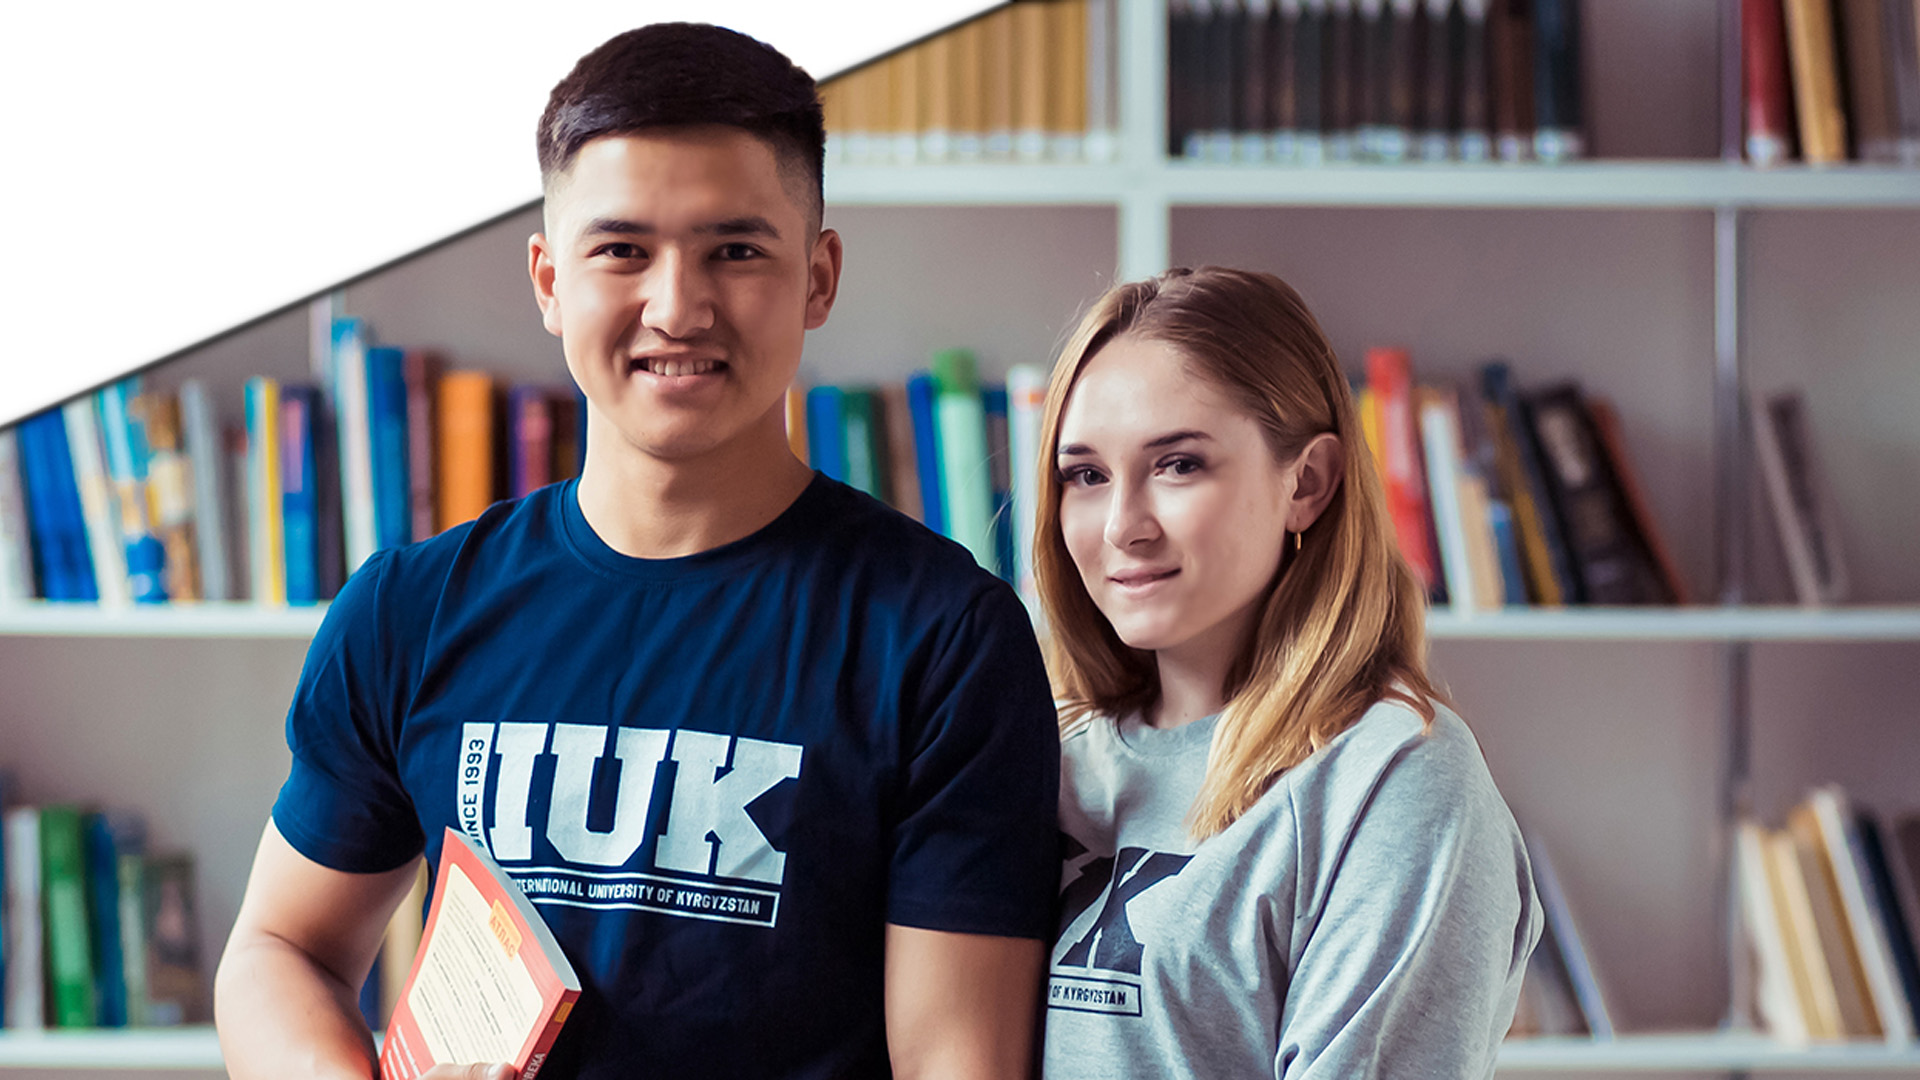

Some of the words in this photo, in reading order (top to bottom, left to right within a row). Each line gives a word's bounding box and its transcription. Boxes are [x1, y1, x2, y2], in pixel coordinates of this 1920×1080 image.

[464, 738, 485, 786] 1993
[489, 722, 804, 885] IUK
[587, 883, 654, 900] UNIVERSITY
[656, 888, 675, 904] OF
[675, 890, 761, 915] KYRGYZSTAN
[1052, 985, 1063, 999] OF
[1063, 986, 1127, 1006] KYRGYZSTAN
[521, 1053, 546, 1080] ВЕКА
